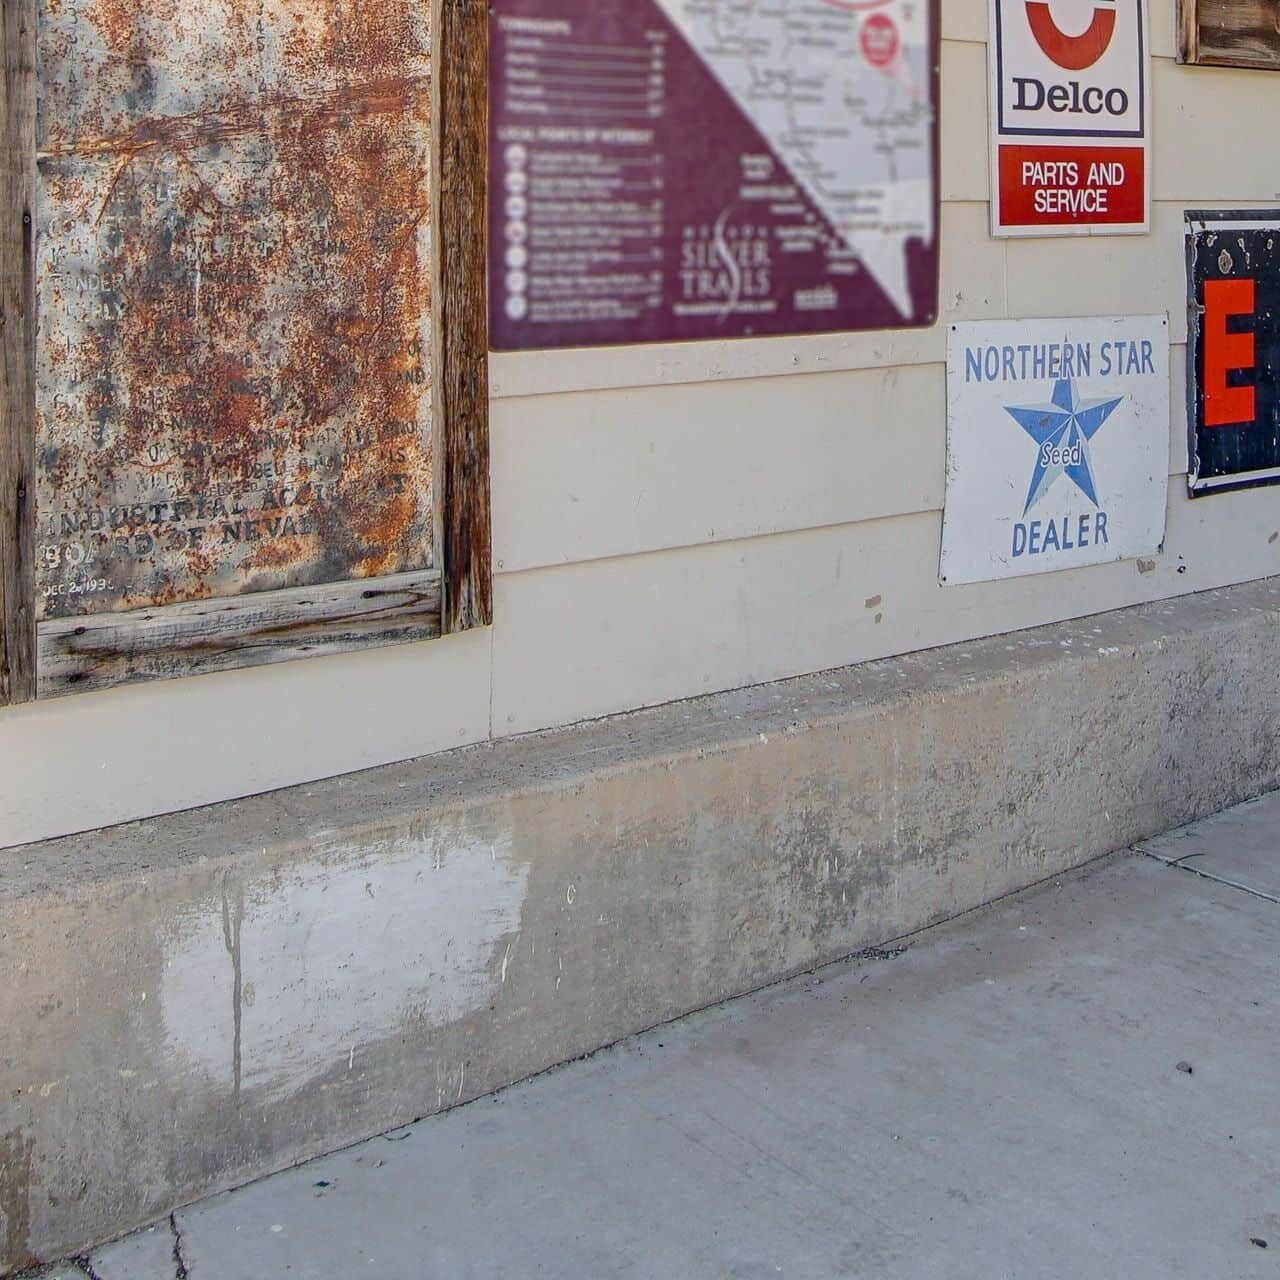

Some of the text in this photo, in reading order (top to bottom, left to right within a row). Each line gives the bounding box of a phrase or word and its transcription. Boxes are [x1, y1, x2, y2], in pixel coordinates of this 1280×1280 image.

[1012, 77, 1129, 116] Delco
[1022, 161, 1125, 186] PARTS AND
[1033, 188, 1108, 213] SERVICE
[965, 340, 1155, 383] NORTHERN STAR
[1203, 278, 1256, 427] E
[1041, 439, 1082, 467] Seed
[1012, 511, 1109, 558] DEALER
